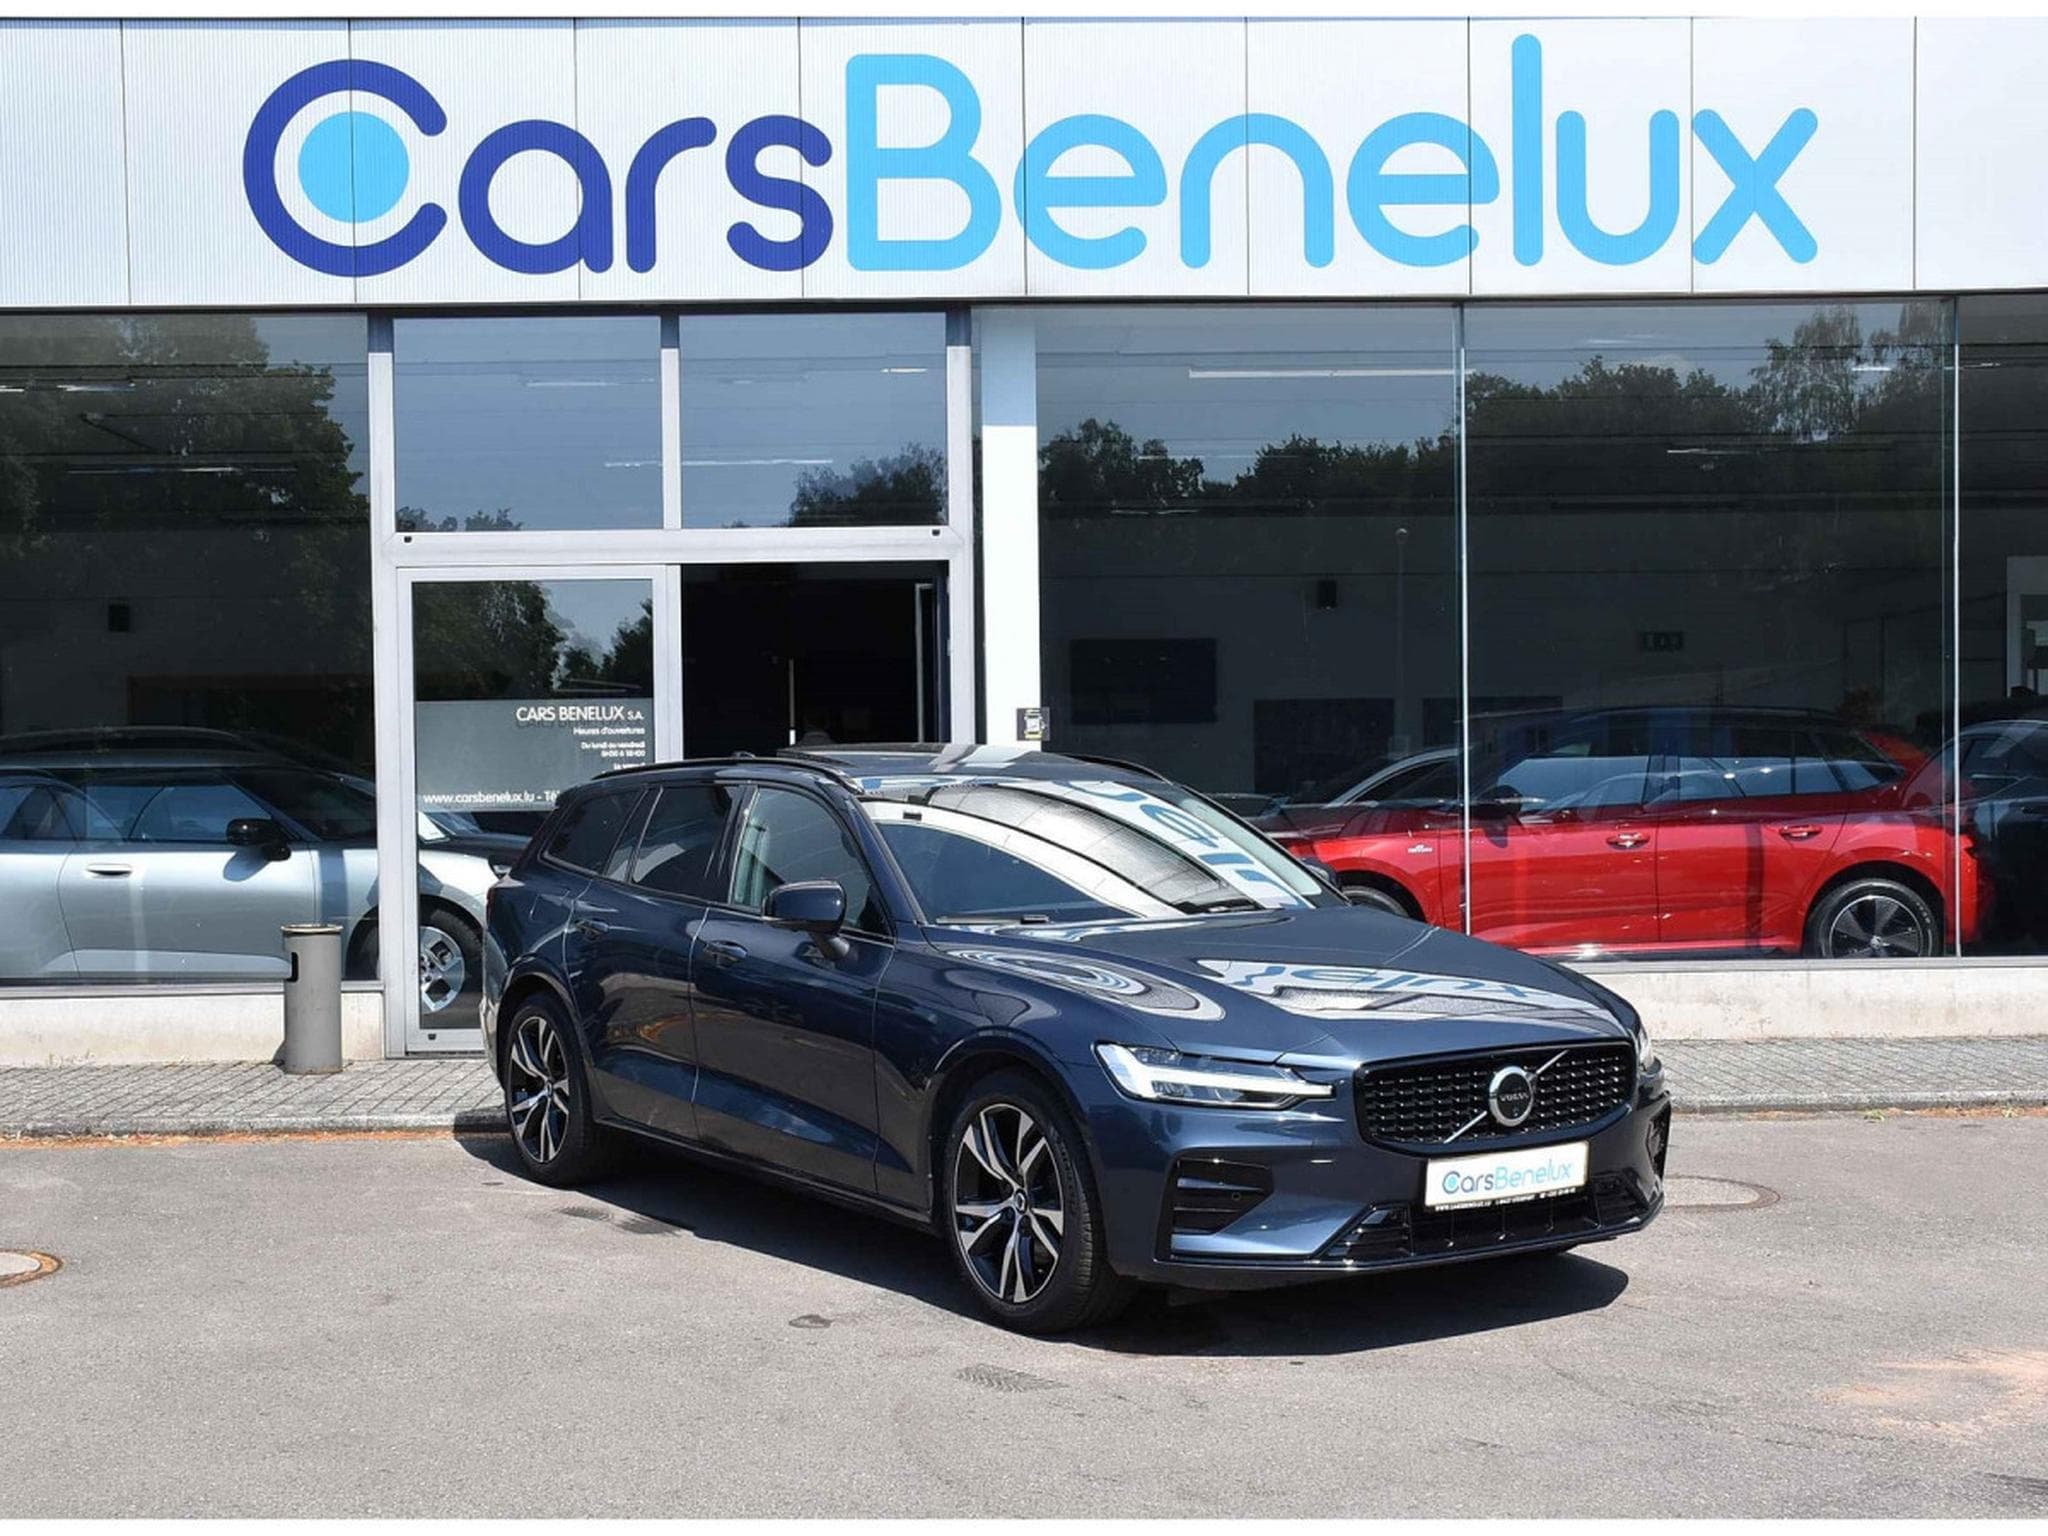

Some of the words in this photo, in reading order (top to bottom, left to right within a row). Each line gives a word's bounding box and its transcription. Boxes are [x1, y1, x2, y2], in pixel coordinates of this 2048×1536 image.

[243, 34, 1818, 278] CarsBenelux
[516, 706, 555, 722] CARS
[559, 705, 624, 721] BENELUX
[423, 790, 534, 804] www.carsbenelux.lu
[1442, 1159, 1572, 1194] CarsBenelux
